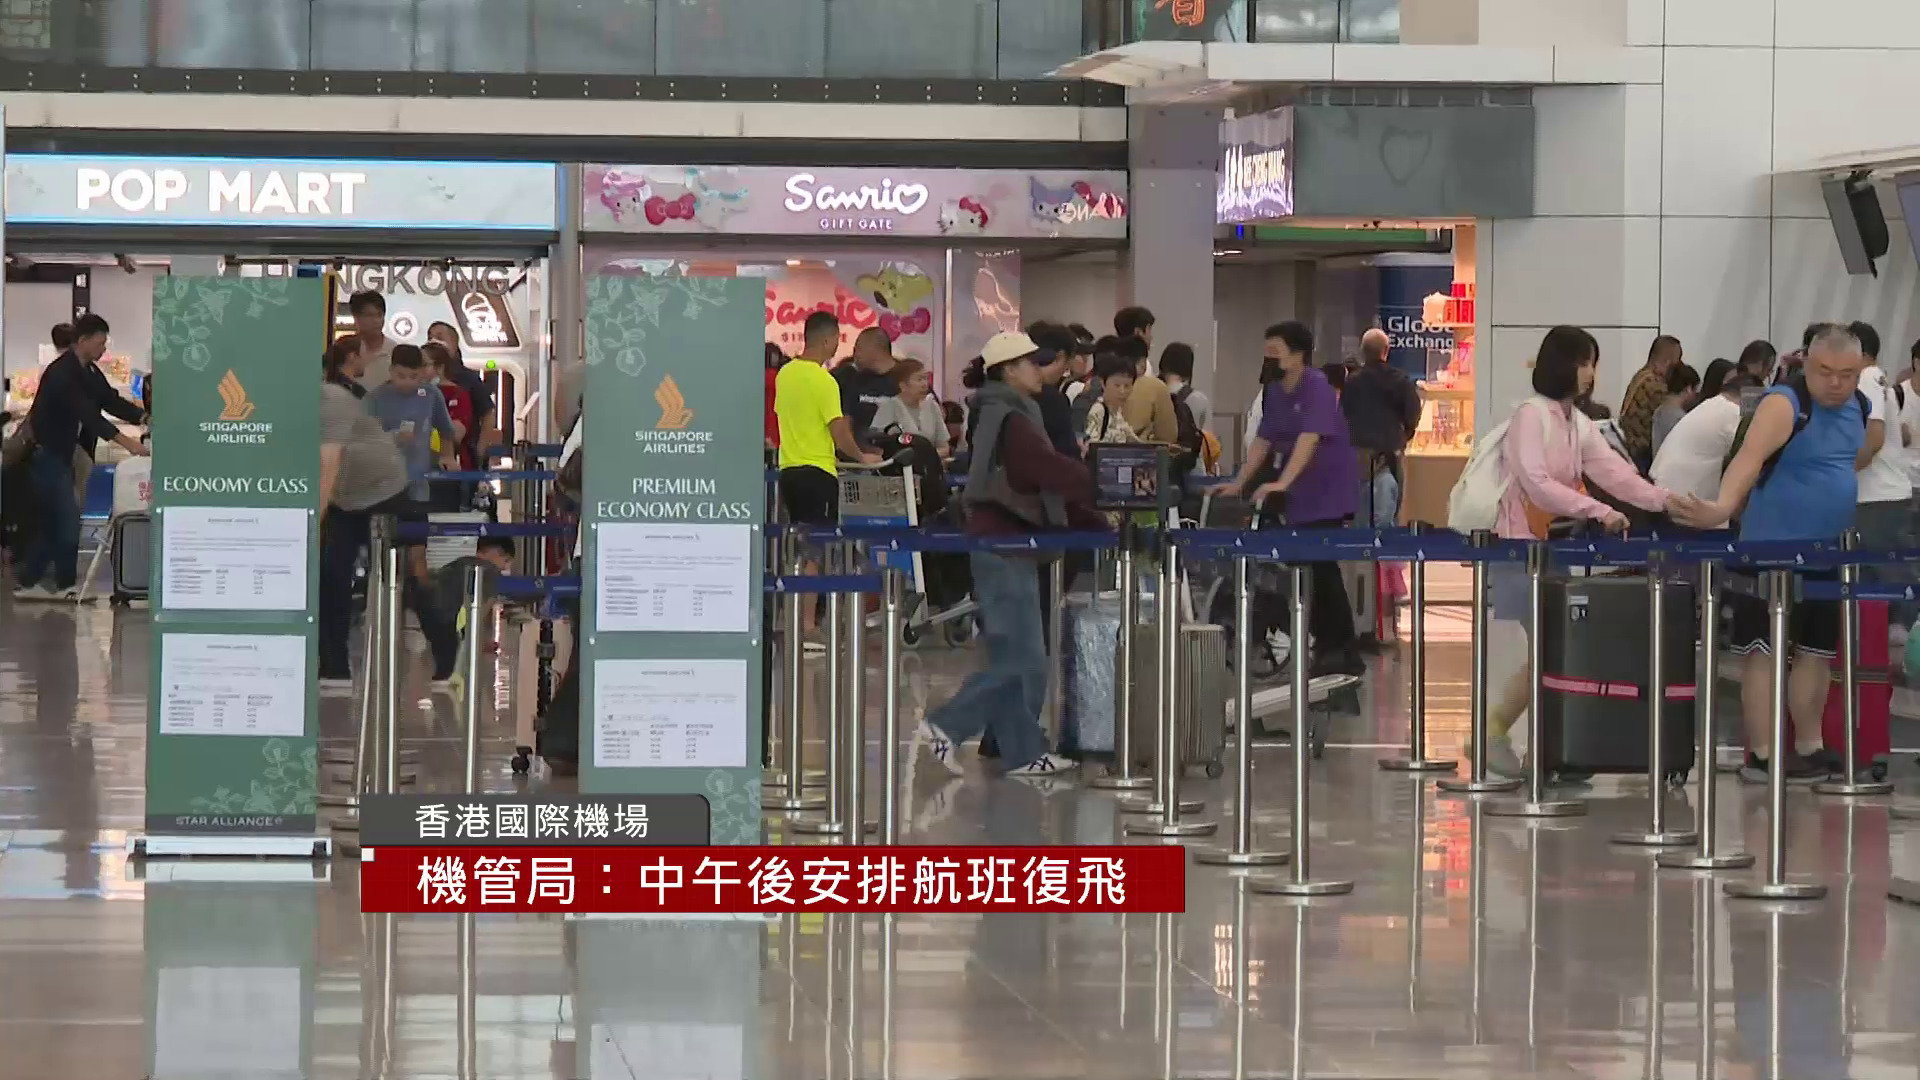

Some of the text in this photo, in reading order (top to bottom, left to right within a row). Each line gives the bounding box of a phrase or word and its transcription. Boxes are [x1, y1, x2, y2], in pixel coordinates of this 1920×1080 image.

[77, 168, 366, 213] POP MART
[785, 173, 929, 214] Sanrio
[820, 218, 892, 230] GIFT GATE
[1388, 333, 1454, 349] Exchang
[199, 422, 273, 433] SINGAPORE
[207, 434, 266, 444] AIRLINES
[635, 430, 713, 442] SINGAPORE
[643, 443, 706, 454] AIRLINES
[163, 476, 252, 493] ECONOMY
[256, 477, 308, 494] CLASS
[633, 477, 716, 495] PREMIUM
[597, 501, 751, 519] ECONOMY CLASS
[175, 815, 273, 827] STAR ALLIANCE
